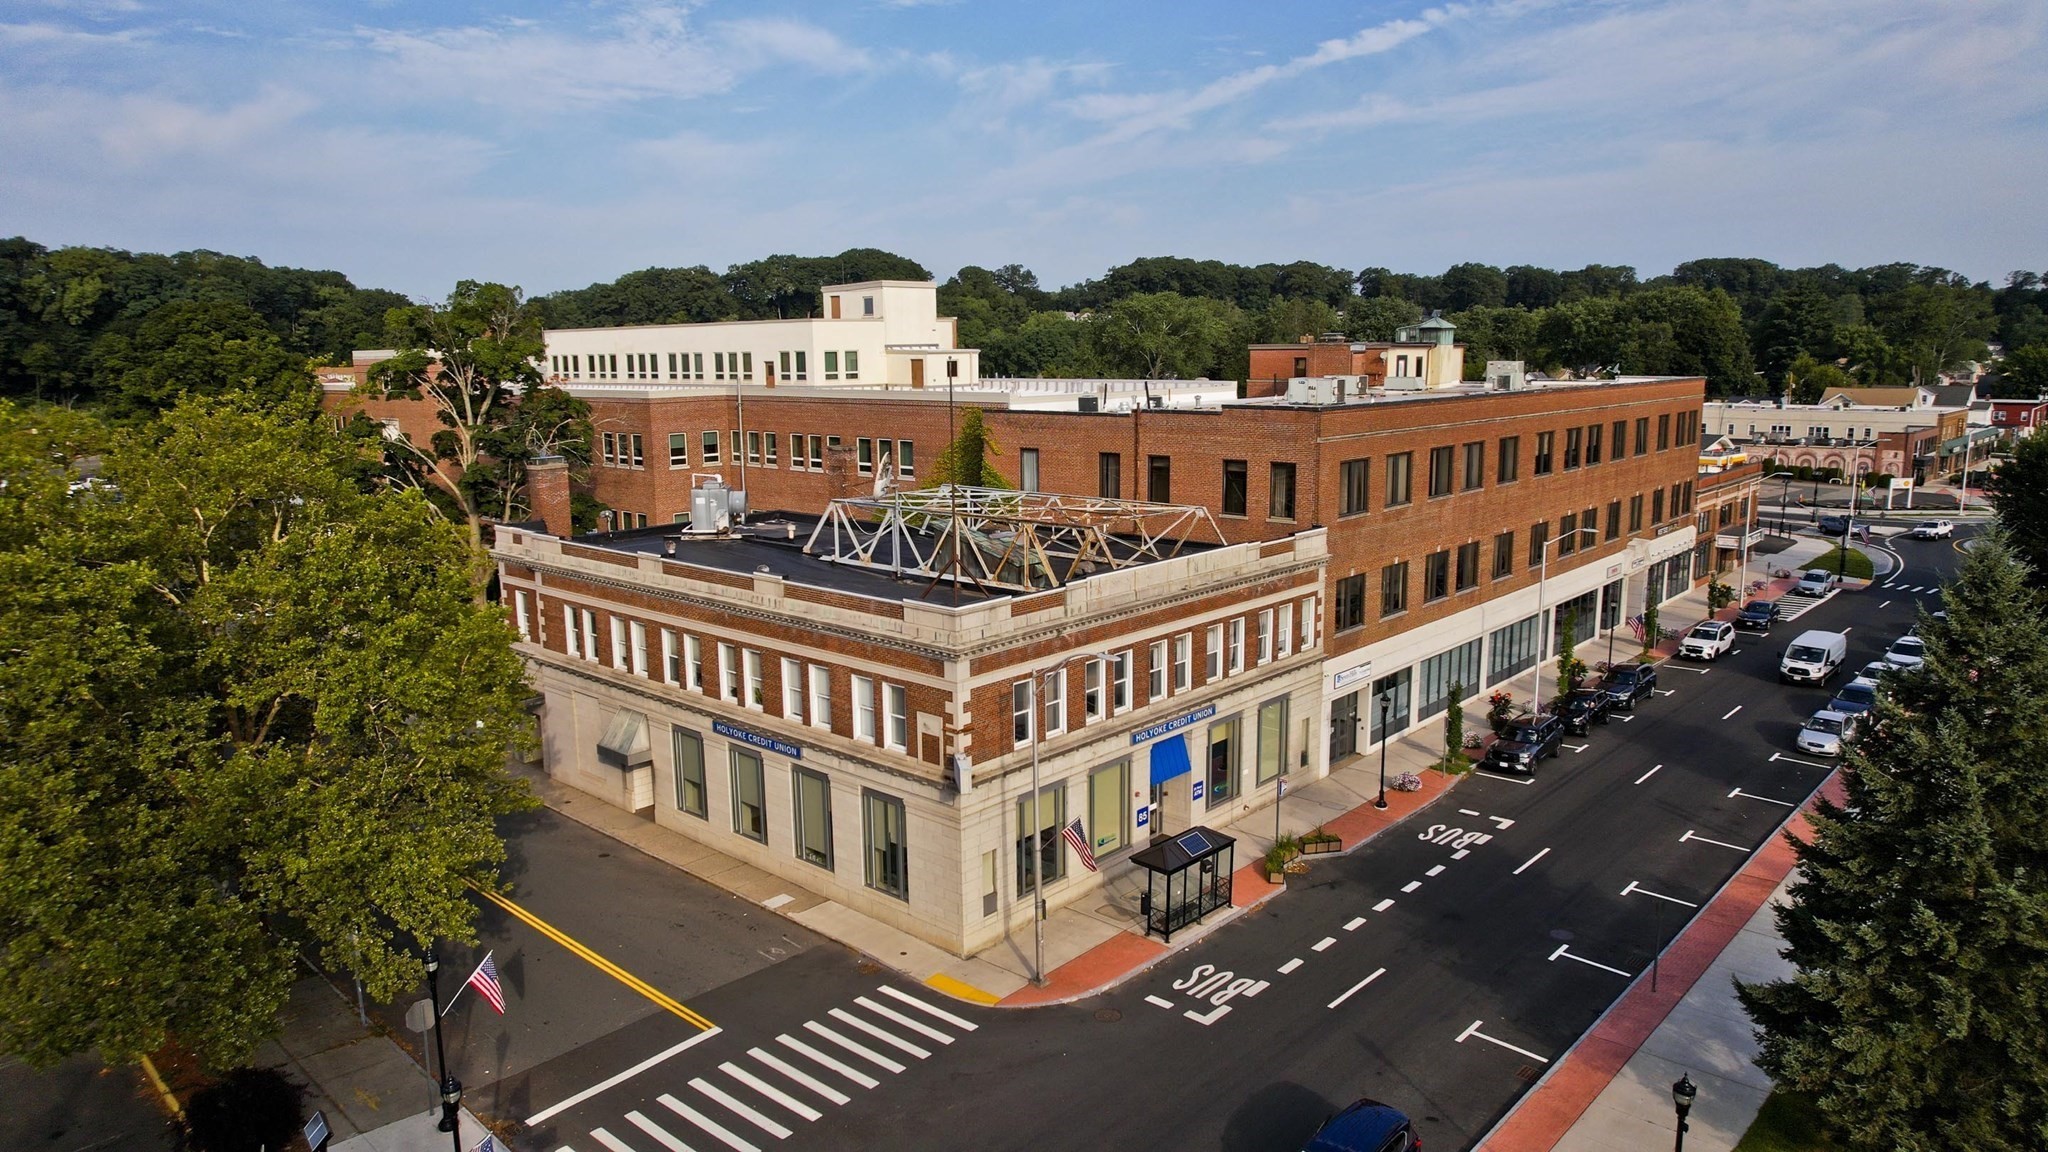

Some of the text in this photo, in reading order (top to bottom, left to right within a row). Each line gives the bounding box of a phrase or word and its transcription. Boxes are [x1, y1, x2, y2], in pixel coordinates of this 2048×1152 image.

[716, 723, 797, 756] HOLYOKE CREDIT UNION
[1135, 707, 1213, 743] HOLYOKE CREDIT UNION
[1138, 811, 1148, 822] 85
[1418, 824, 1484, 850] BUS
[1172, 964, 1256, 1007] BUS
